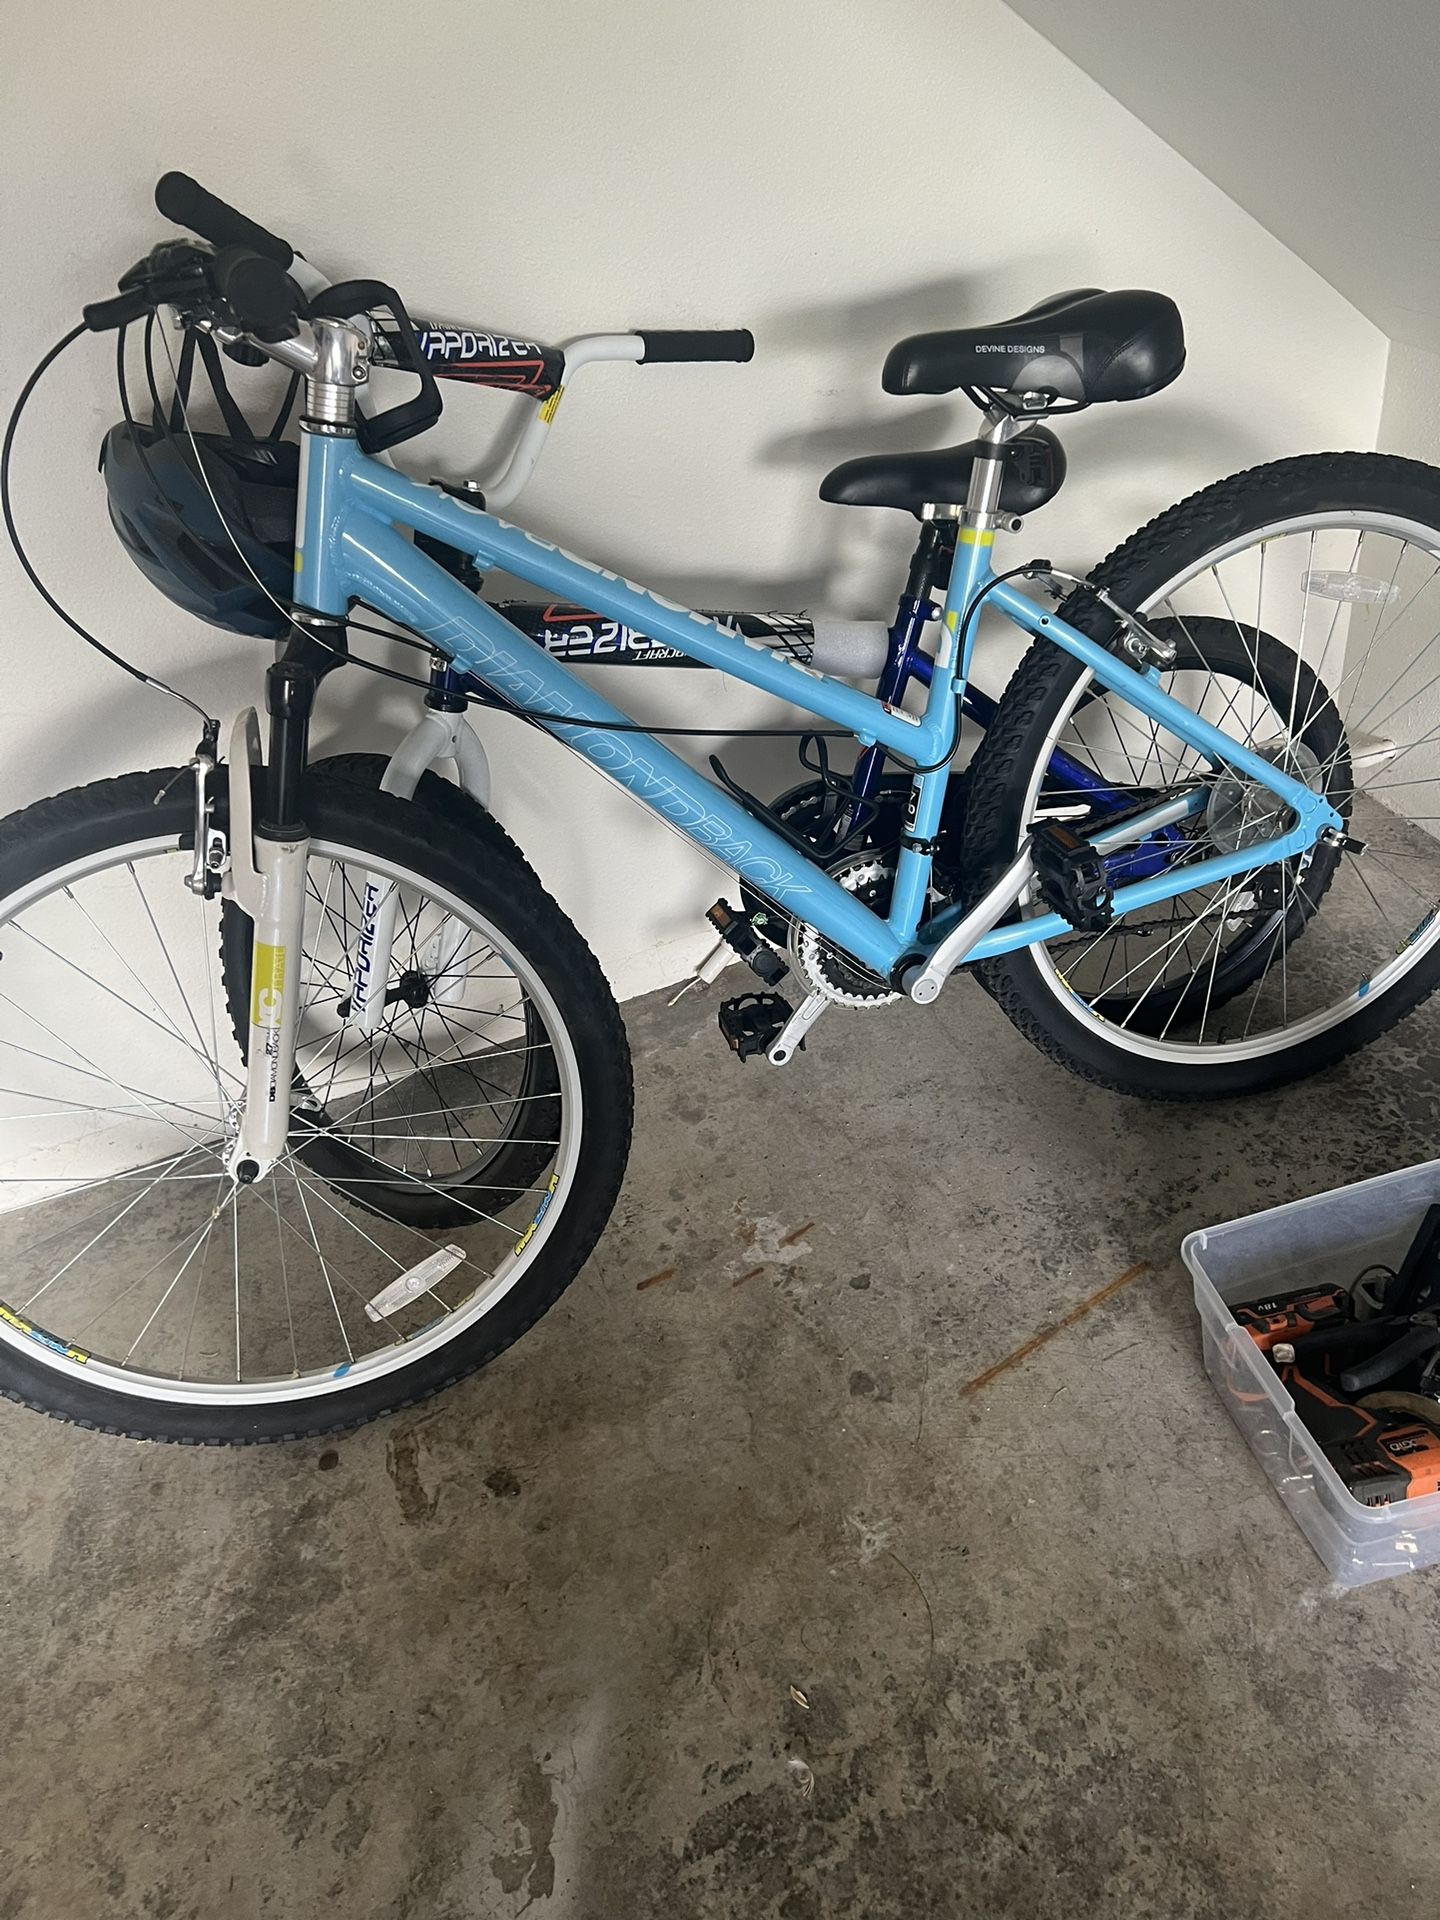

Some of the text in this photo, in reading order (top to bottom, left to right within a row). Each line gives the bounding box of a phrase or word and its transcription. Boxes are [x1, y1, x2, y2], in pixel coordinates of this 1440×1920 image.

[975, 345, 1046, 354] DEVINE DESIGNS
[424, 615, 813, 902] DIAMONDBACK
